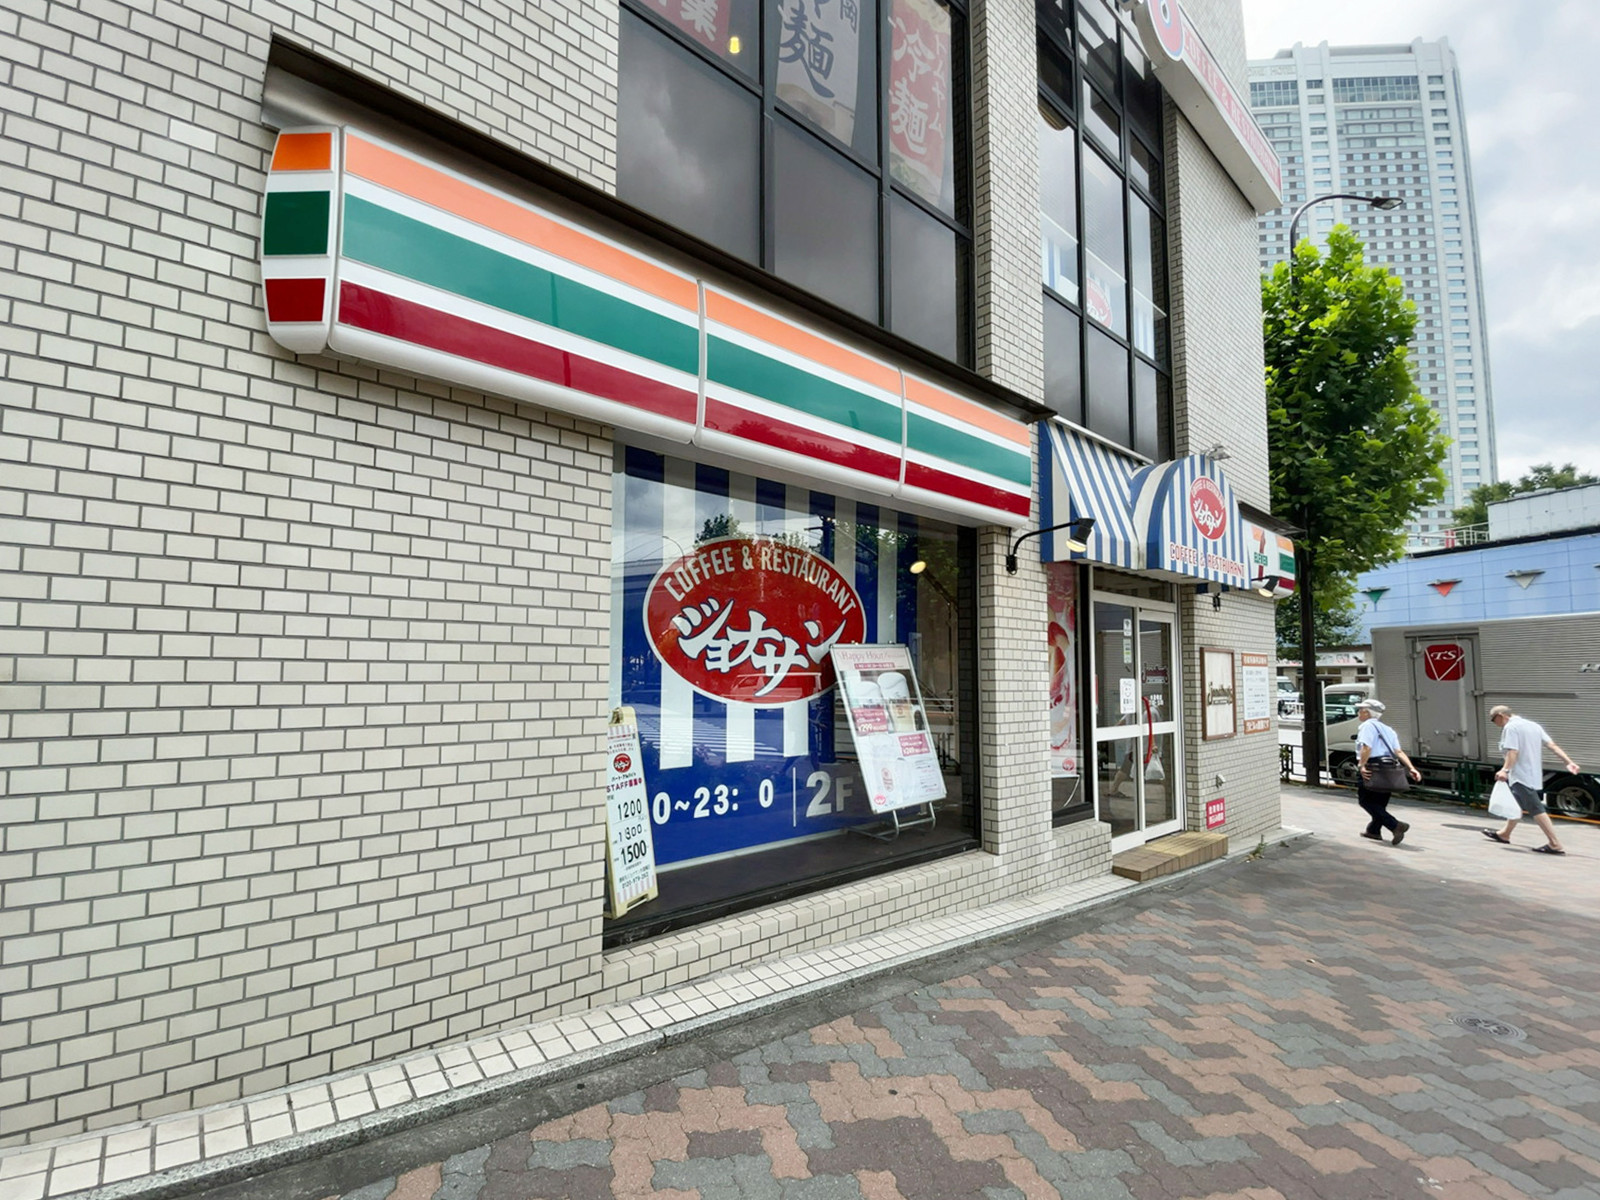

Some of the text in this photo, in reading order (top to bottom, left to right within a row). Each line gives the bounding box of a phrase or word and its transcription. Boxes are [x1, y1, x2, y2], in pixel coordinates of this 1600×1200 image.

[779, 0, 835, 98] 麺
[888, 15, 934, 155] 冷麺
[664, 547, 857, 616] COFFEE & RESTAURANT
[1170, 543, 1245, 578] COFFEE & RESTAURANT
[671, 597, 846, 697] ジョナサン
[617, 798, 642, 821] 1200
[806, 771, 853, 817] 2F
[620, 839, 647, 866] 1500
